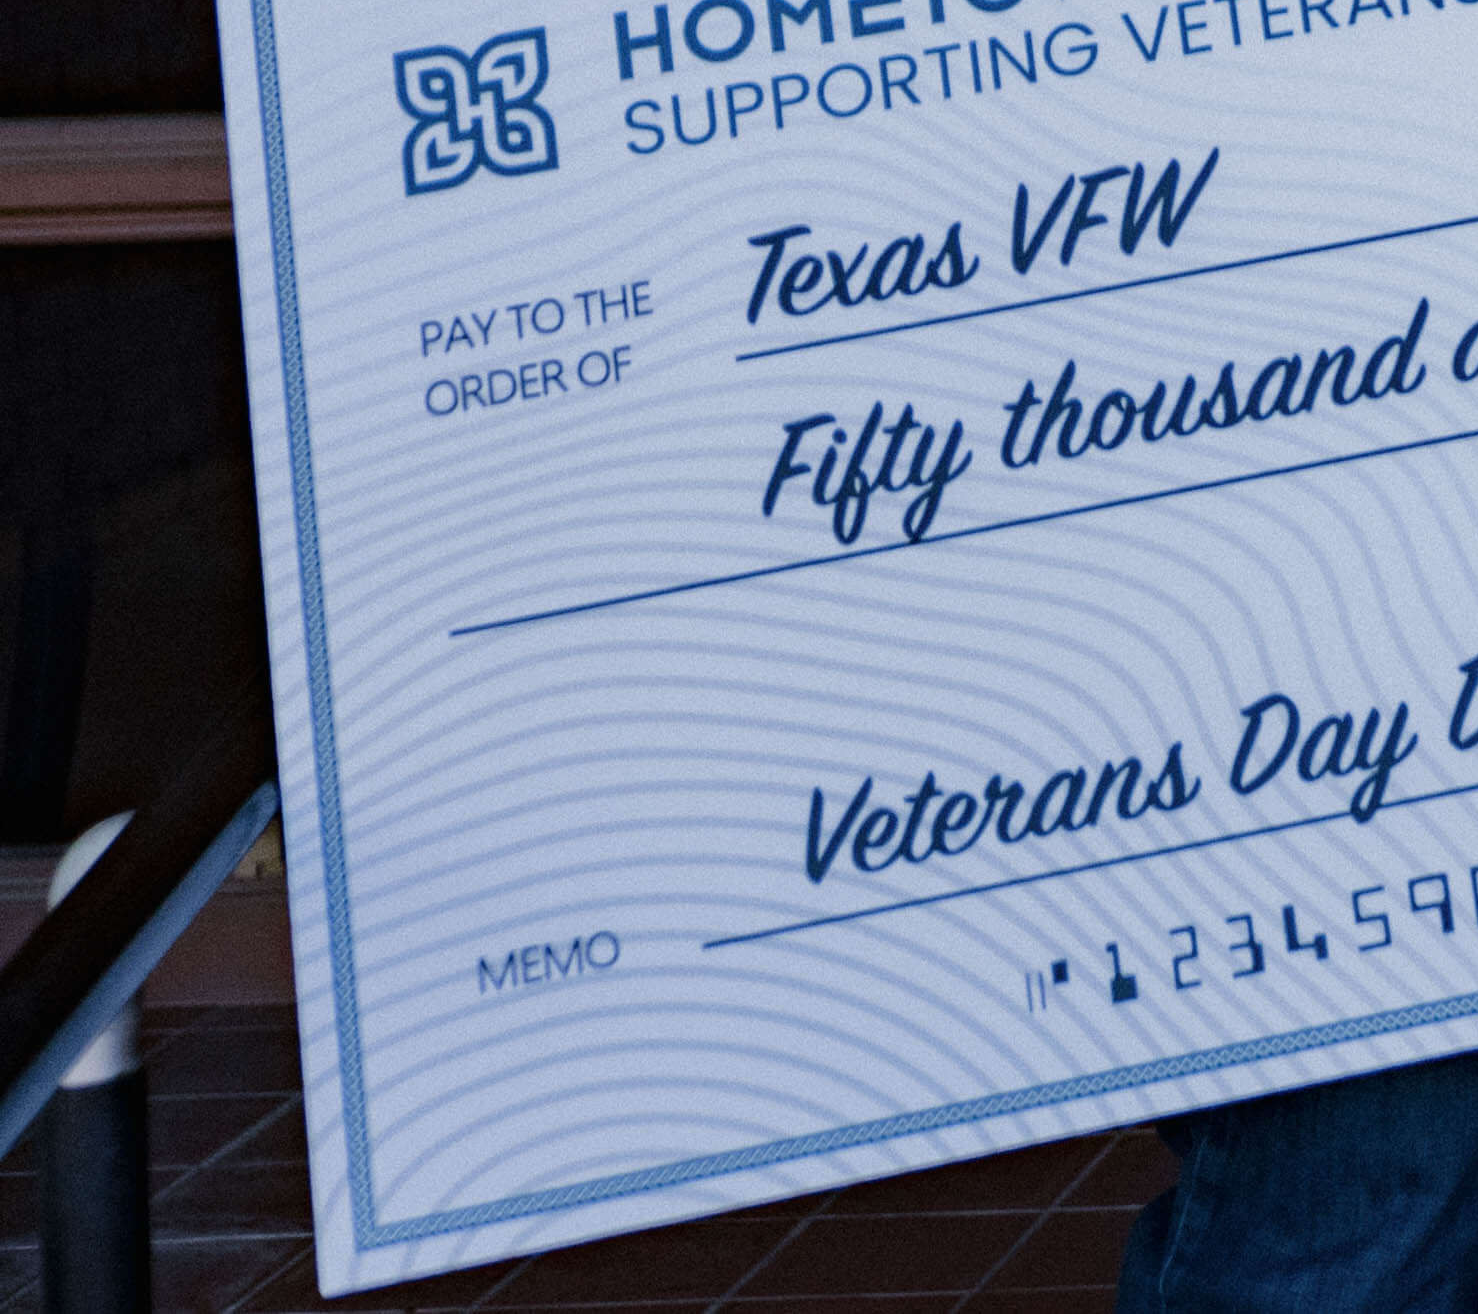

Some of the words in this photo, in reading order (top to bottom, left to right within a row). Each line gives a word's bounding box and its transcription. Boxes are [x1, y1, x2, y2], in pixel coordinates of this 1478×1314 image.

[623, 20, 1100, 157] SUPPORTING
[745, 220, 982, 327] Texas
[1009, 145, 1222, 277] VFW
[419, 315, 496, 358] PAY
[506, 297, 567, 339] TO
[573, 279, 654, 327] THE
[424, 358, 569, 418] ORDER
[575, 344, 632, 389] OF
[761, 401, 973, 544] Fifty
[999, 295, 1432, 471] thousand
[476, 930, 621, 990] MEMO
[803, 740, 1203, 886] Veterans
[1227, 691, 1418, 823] Day
